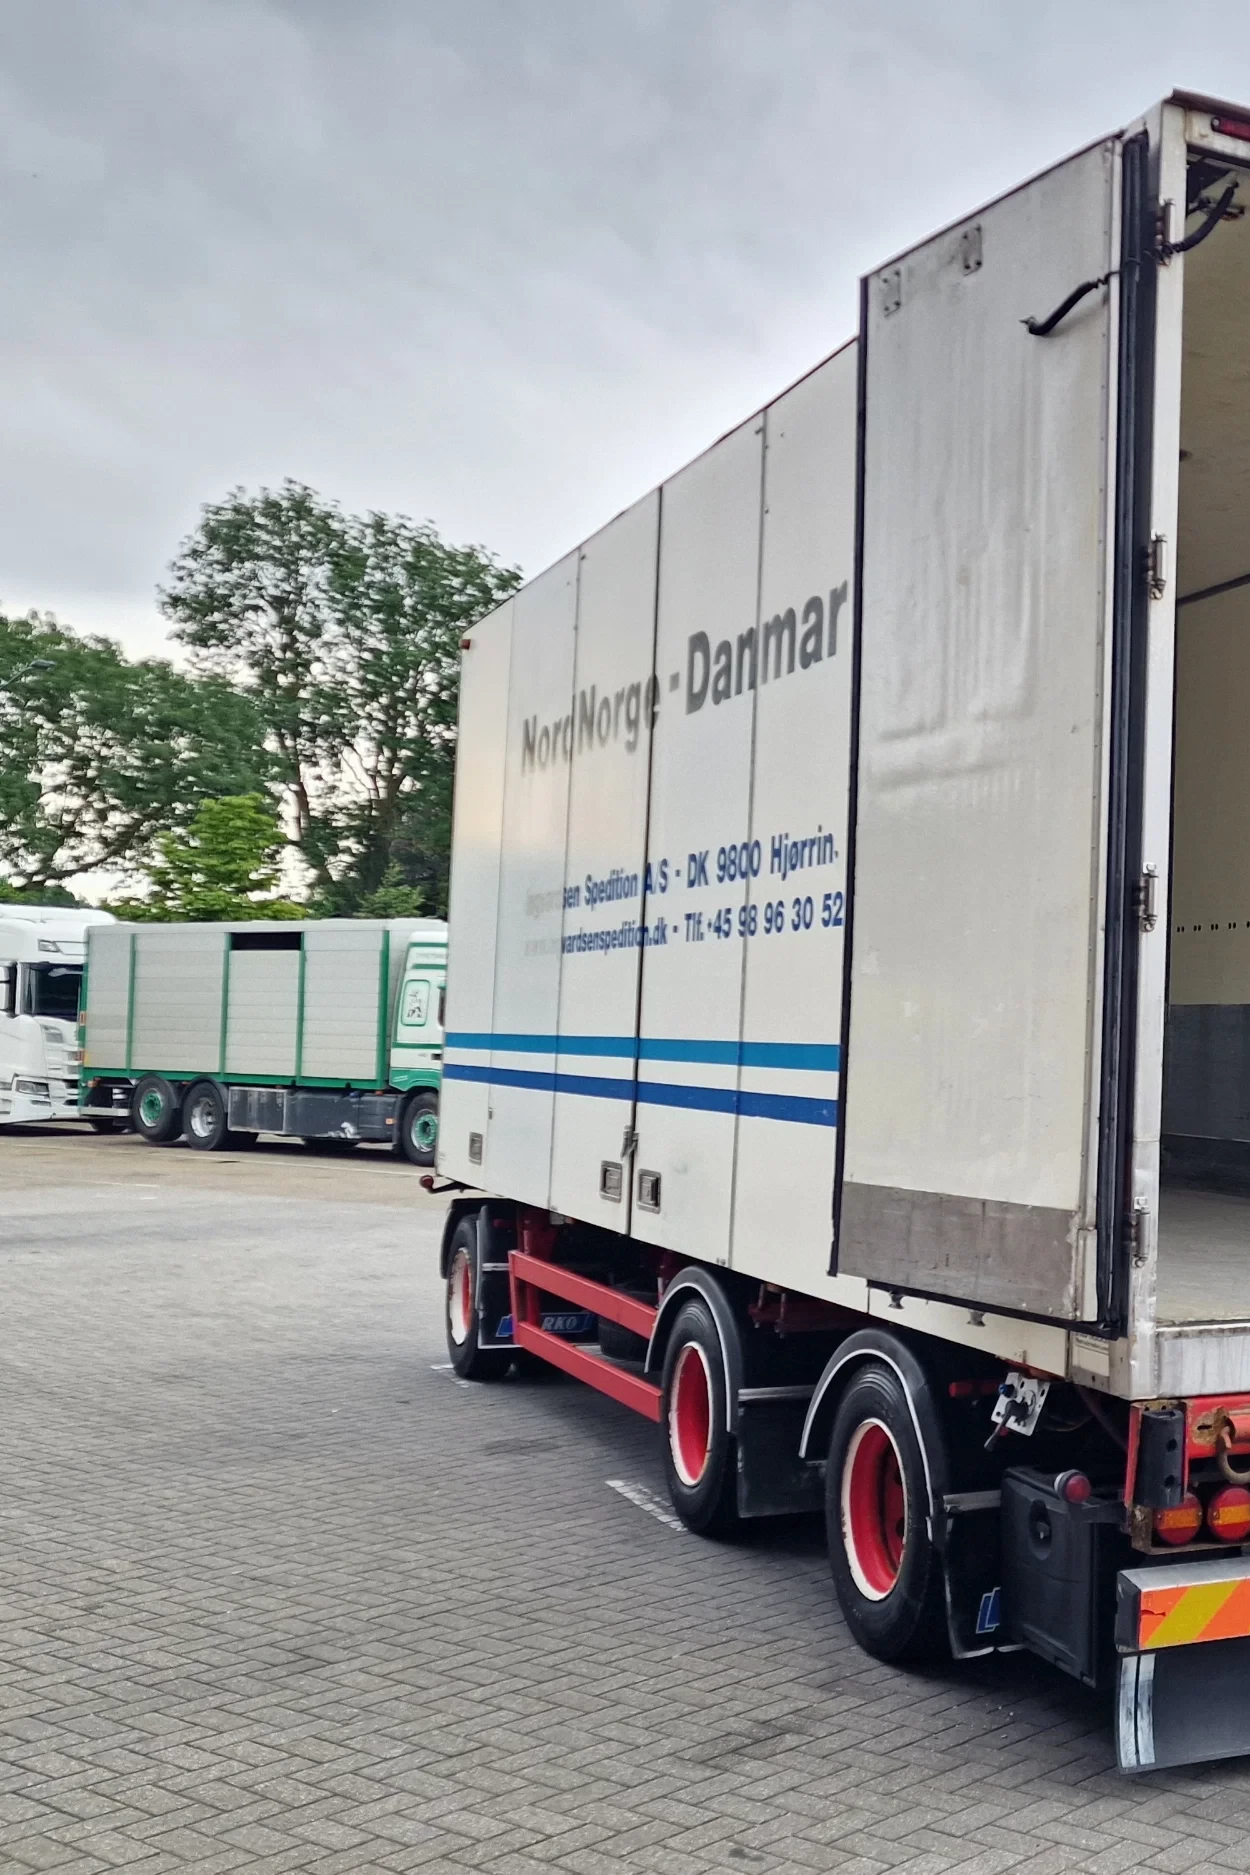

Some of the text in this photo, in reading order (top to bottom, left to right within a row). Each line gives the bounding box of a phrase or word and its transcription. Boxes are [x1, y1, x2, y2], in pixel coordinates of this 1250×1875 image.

[686, 580, 848, 716] Danmar
[584, 867, 638, 911] Spedition
[687, 850, 709, 888] DK
[716, 839, 761, 883] 9800
[738, 904, 757, 937] 98
[764, 900, 785, 934] 96
[791, 897, 813, 931] 30
[821, 891, 844, 927] 52
[543, 1316, 577, 1331] RKO
